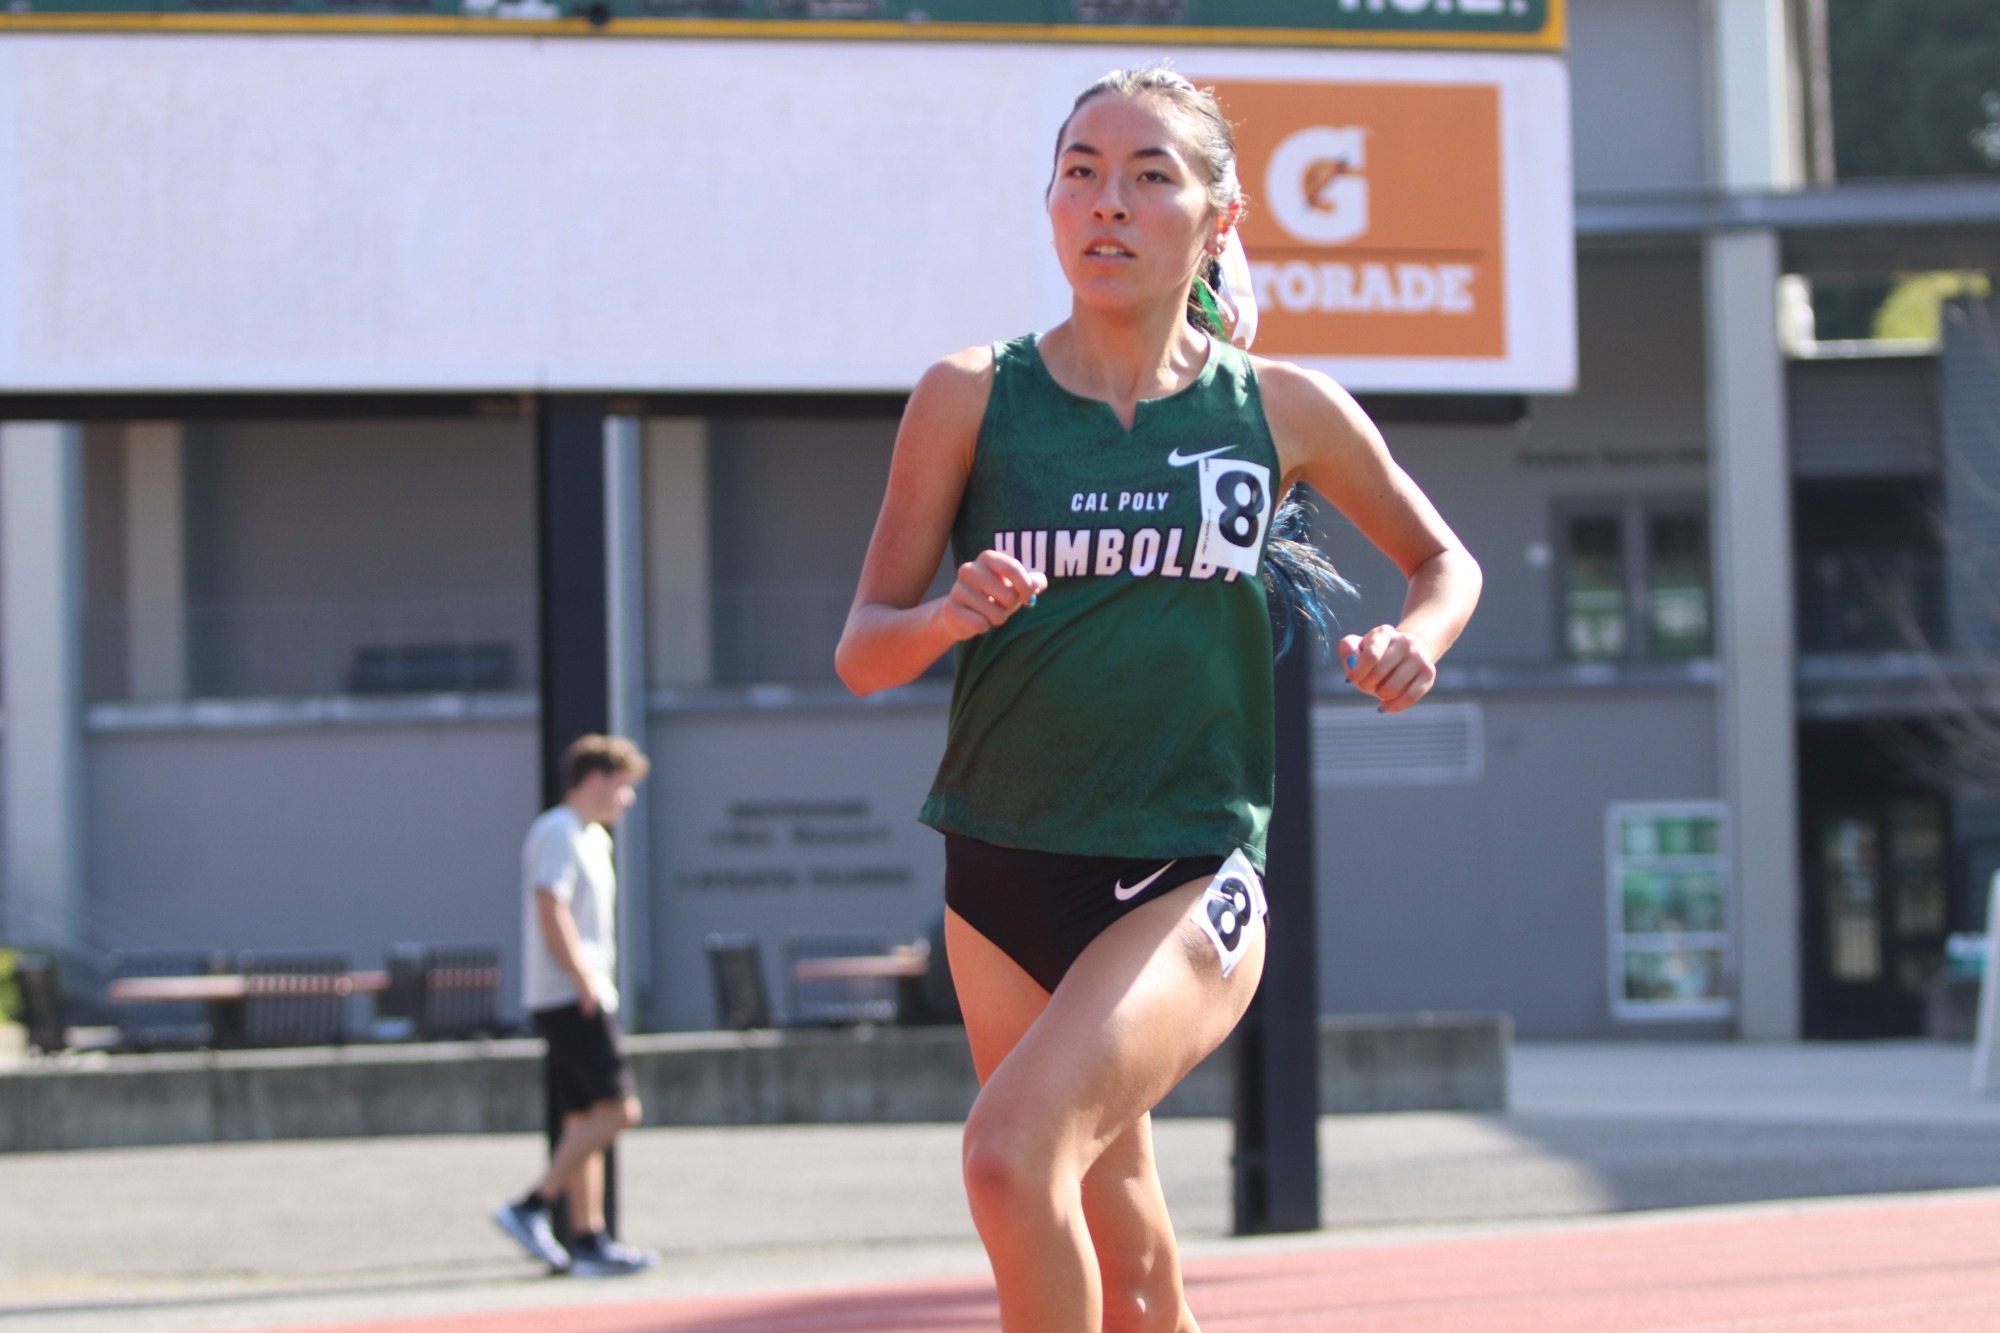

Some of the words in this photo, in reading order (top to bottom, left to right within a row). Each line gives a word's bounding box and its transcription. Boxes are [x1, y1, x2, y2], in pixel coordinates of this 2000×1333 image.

[1264, 125, 1371, 245] G
[1252, 261, 1476, 314] TORADE
[1071, 493, 1109, 512] CAL
[1118, 492, 1169, 511] POLY
[1215, 470, 1265, 548] 8
[1206, 876, 1252, 952] 8
